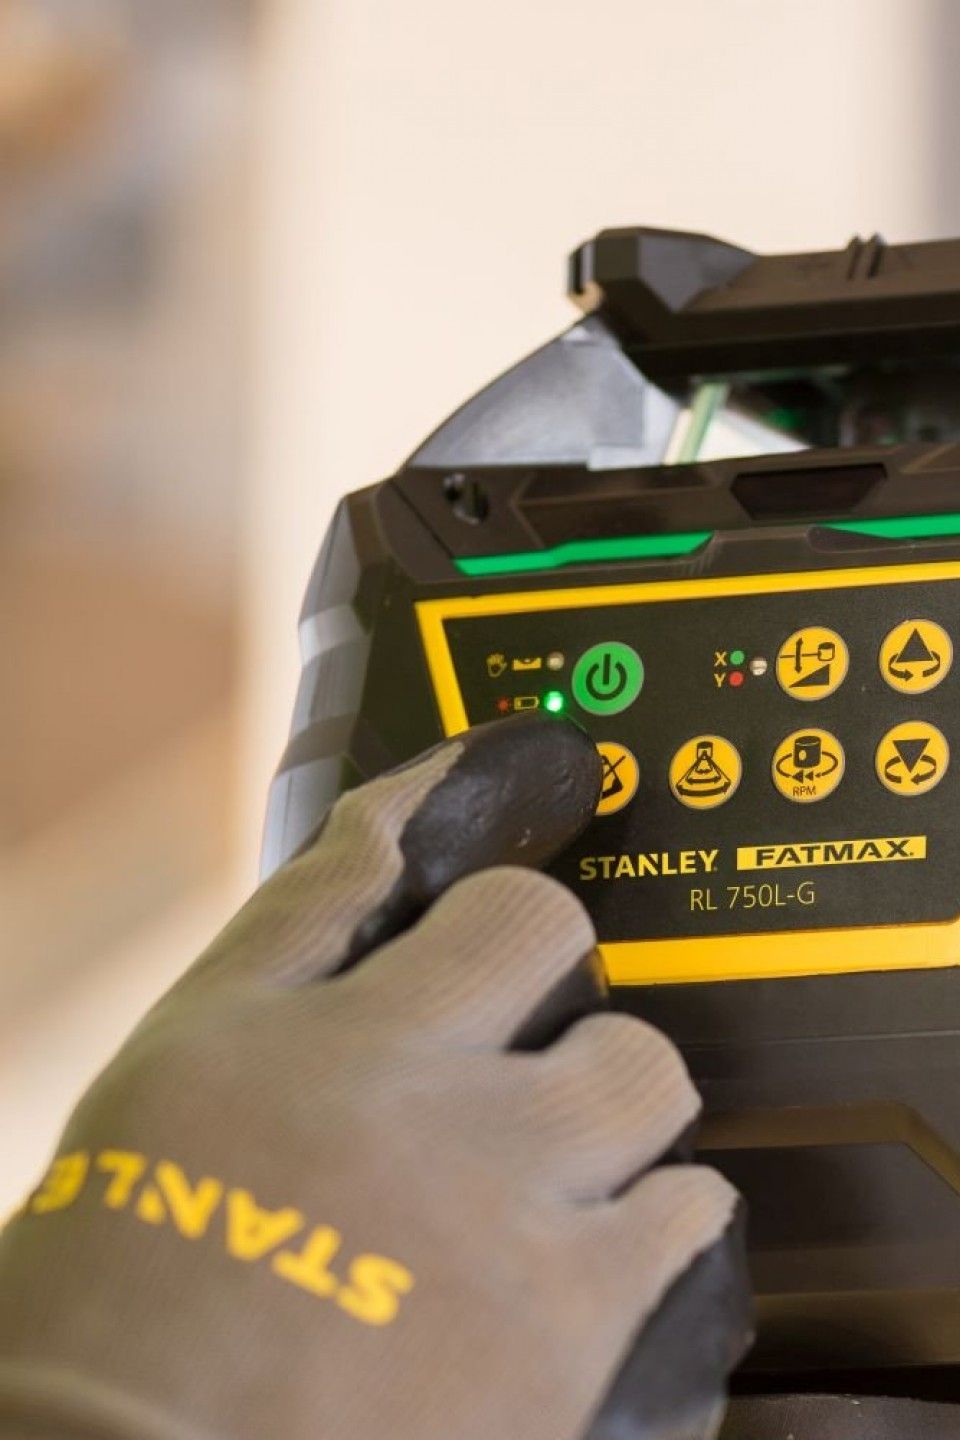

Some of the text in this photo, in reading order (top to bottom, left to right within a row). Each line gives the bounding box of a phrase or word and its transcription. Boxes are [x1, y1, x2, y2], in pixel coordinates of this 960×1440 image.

[714, 651, 727, 667] X
[714, 672, 726, 688] Y
[792, 785, 817, 796] RPM
[579, 849, 718, 881] STANLEY
[690, 881, 816, 911] RL 750L-G
